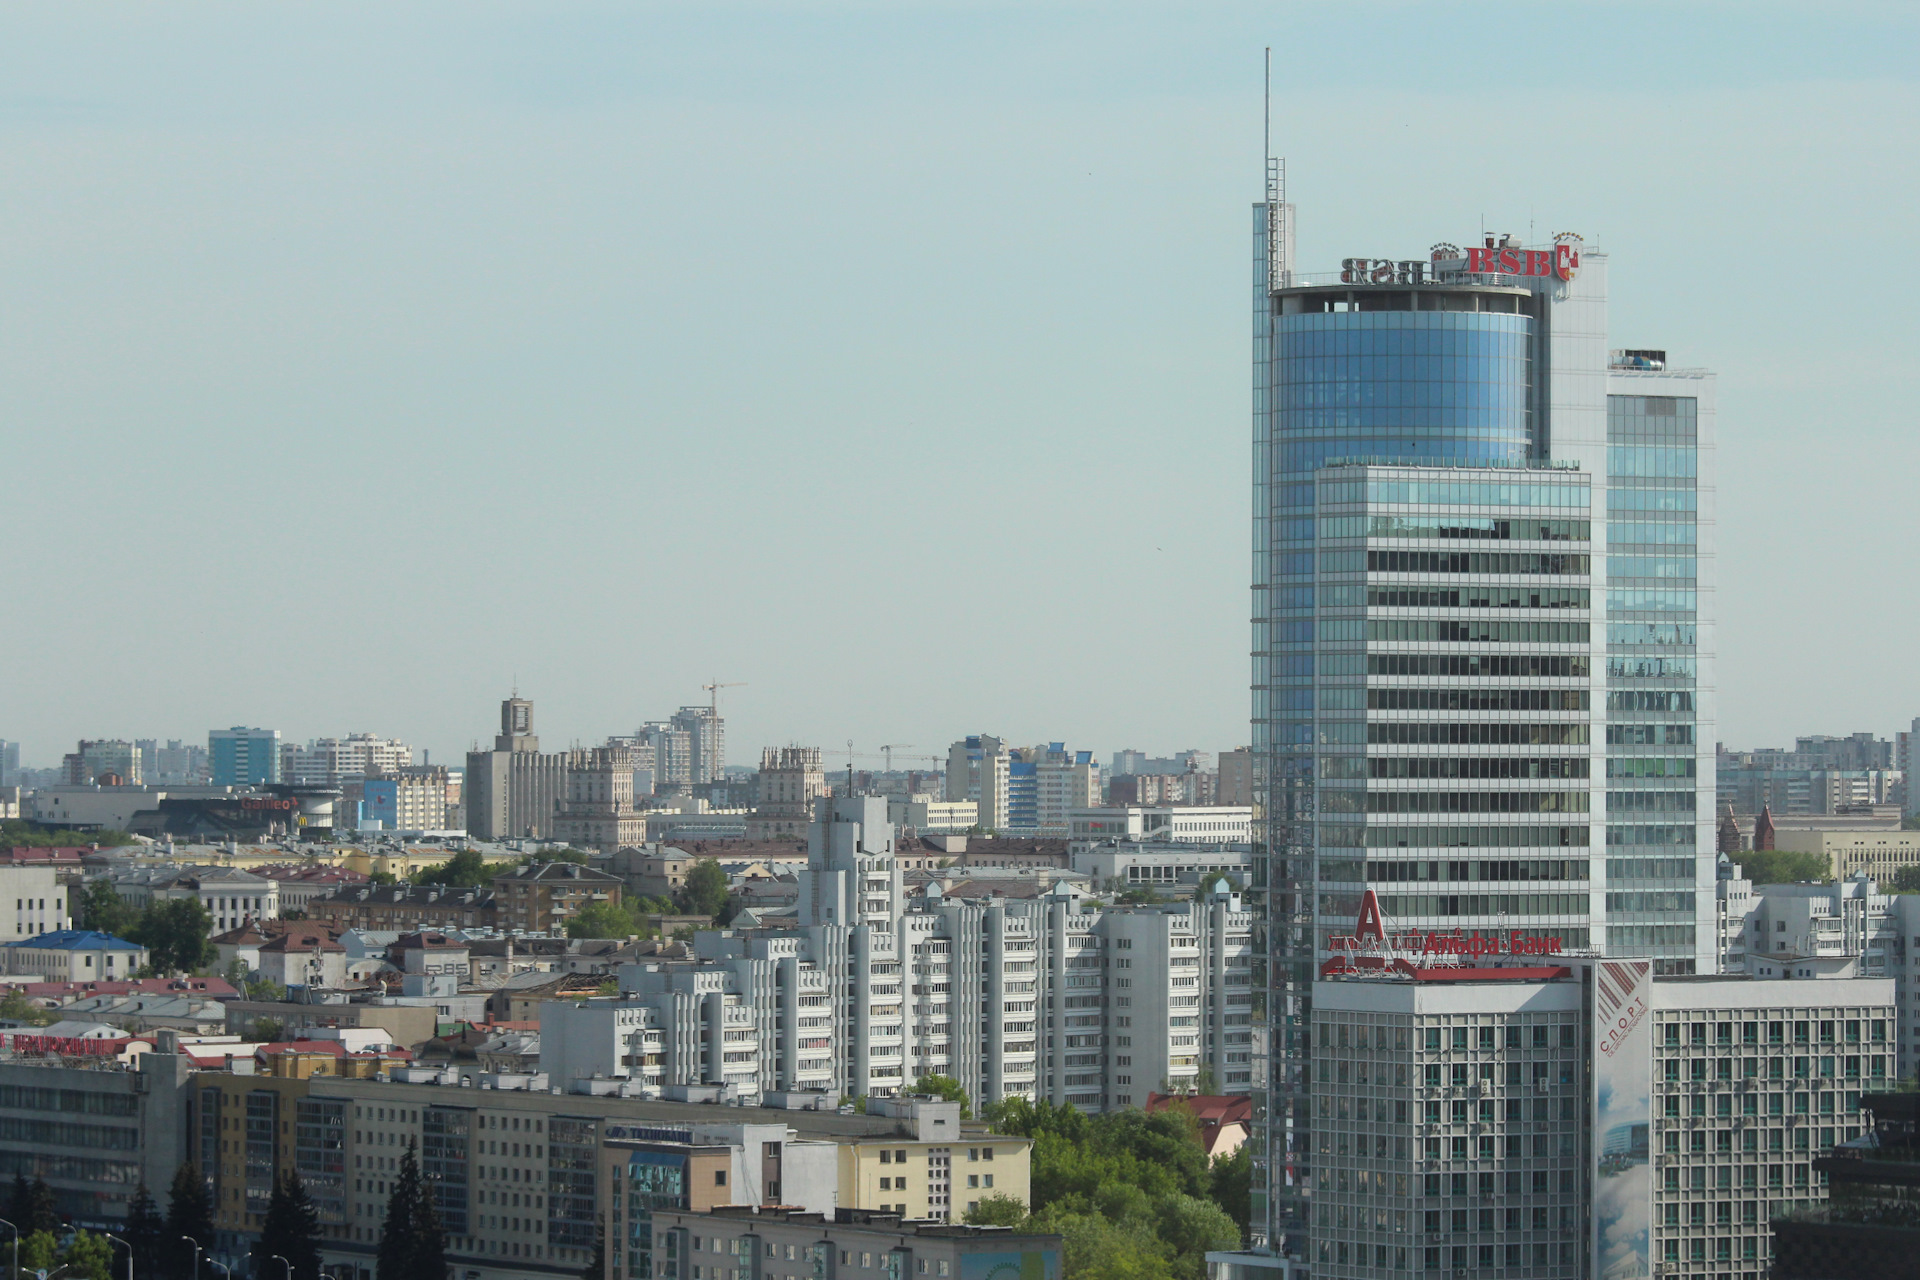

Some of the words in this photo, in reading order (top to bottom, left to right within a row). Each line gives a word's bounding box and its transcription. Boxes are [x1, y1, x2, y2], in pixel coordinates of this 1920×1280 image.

[1464, 247, 1551, 277] BSB
[241, 796, 290, 810] Galileo
[1600, 996, 1642, 1052] СПОРТ
